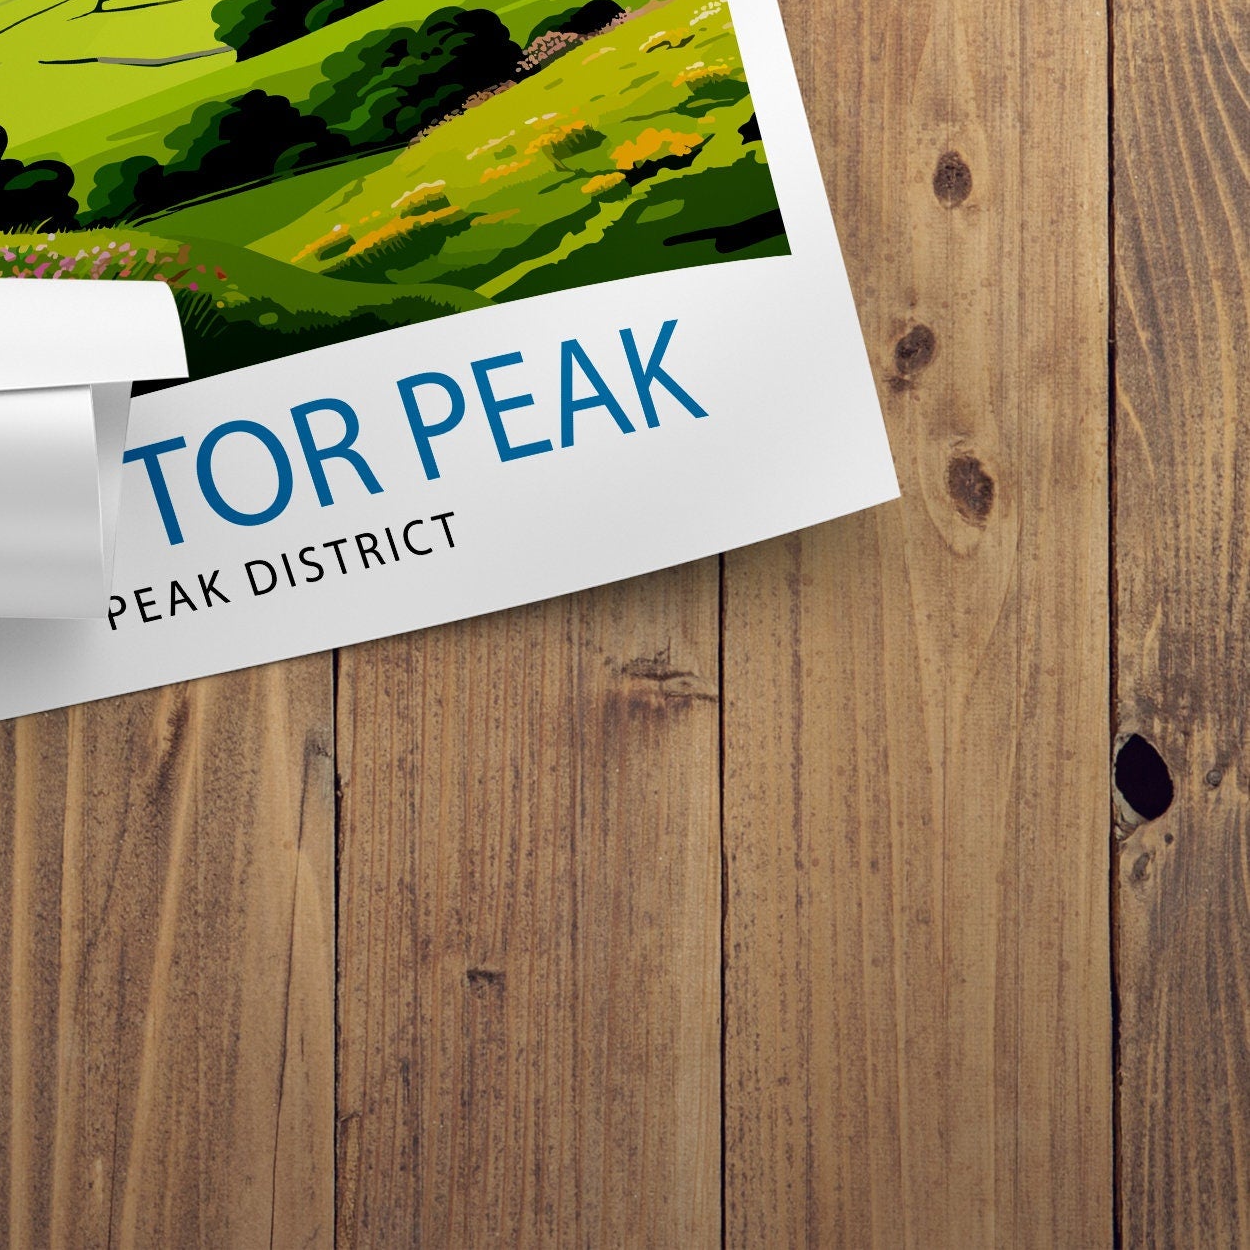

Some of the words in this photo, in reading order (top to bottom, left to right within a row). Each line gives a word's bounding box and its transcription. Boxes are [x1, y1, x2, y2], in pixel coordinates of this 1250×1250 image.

[122, 397, 385, 546] TOR
[396, 319, 710, 481] PEAK
[107, 569, 231, 631] PEAK
[244, 511, 456, 597] DISTRICT
